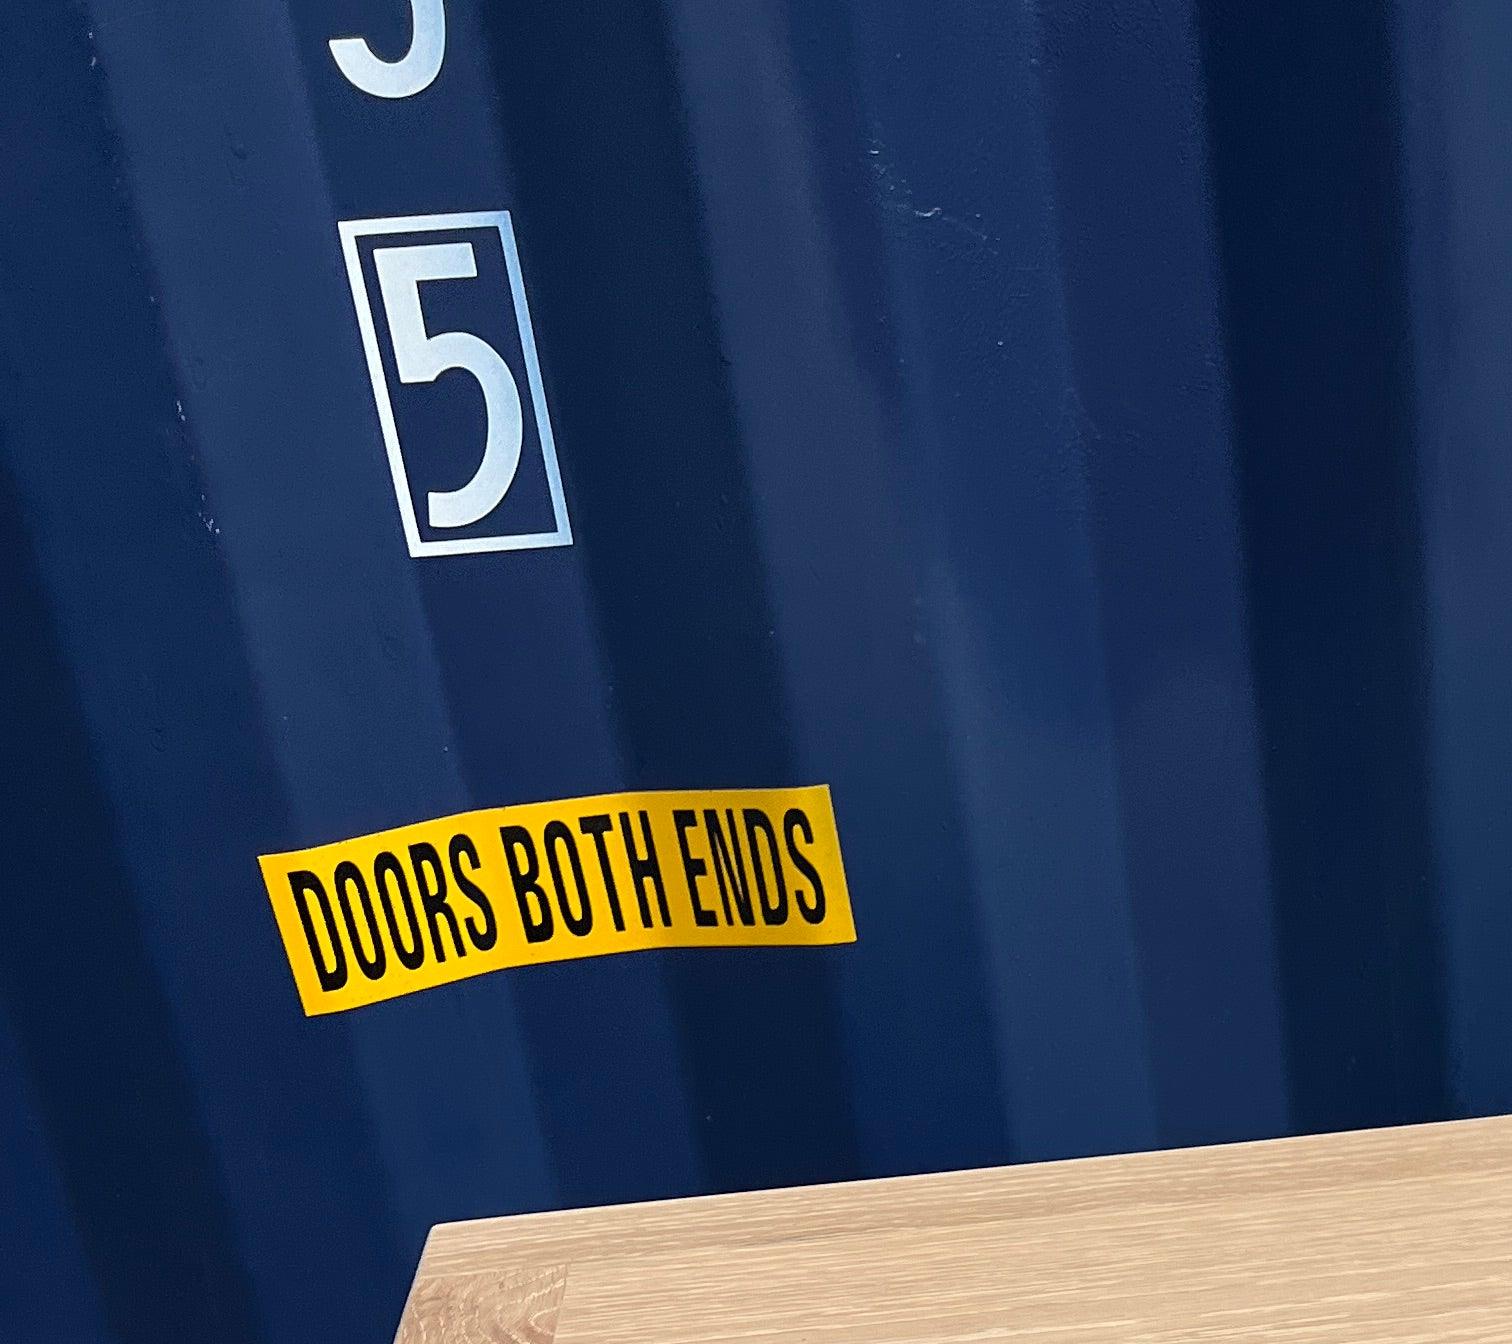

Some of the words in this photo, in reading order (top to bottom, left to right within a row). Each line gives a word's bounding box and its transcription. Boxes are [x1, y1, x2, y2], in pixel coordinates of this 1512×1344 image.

[373, 242, 523, 528] 5
[288, 833, 498, 992] DOORS
[499, 809, 672, 944] BOTH
[674, 807, 826, 928] ENDS
